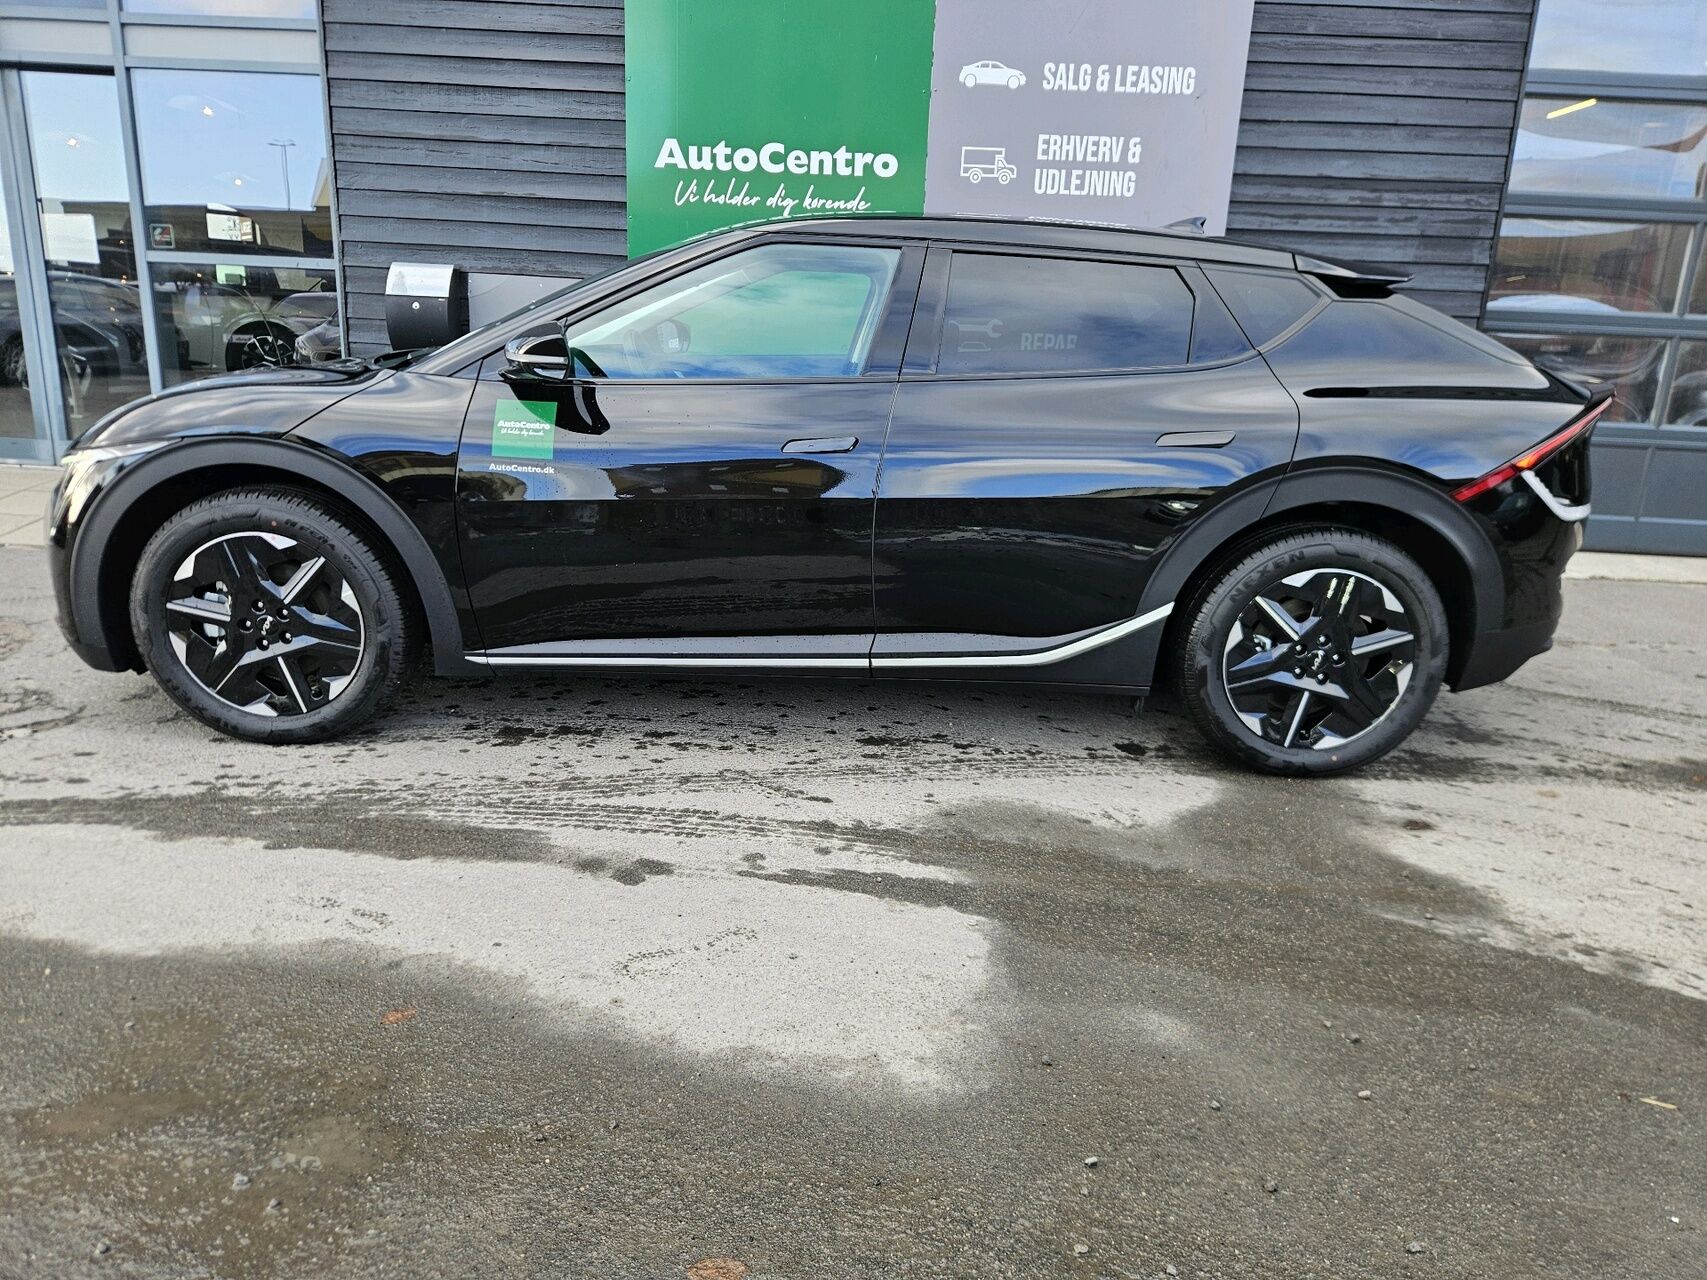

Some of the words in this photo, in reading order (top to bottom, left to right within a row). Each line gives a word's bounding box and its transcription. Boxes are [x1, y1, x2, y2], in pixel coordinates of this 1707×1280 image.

[1042, 62, 1092, 92] SALG
[1096, 64, 1110, 92] &
[1114, 65, 1197, 95] LEASING
[654, 138, 899, 178] AutoCentro
[1036, 133, 1125, 163] ERHVERV
[1127, 137, 1142, 164] &
[674, 179, 699, 207] Vi
[703, 177, 761, 207] holder
[766, 183, 799, 218] dig
[1033, 168, 1136, 197] UDLEJNING
[498, 420, 550, 429] AutoCentro
[489, 463, 555, 474] AutoCentro.dk
